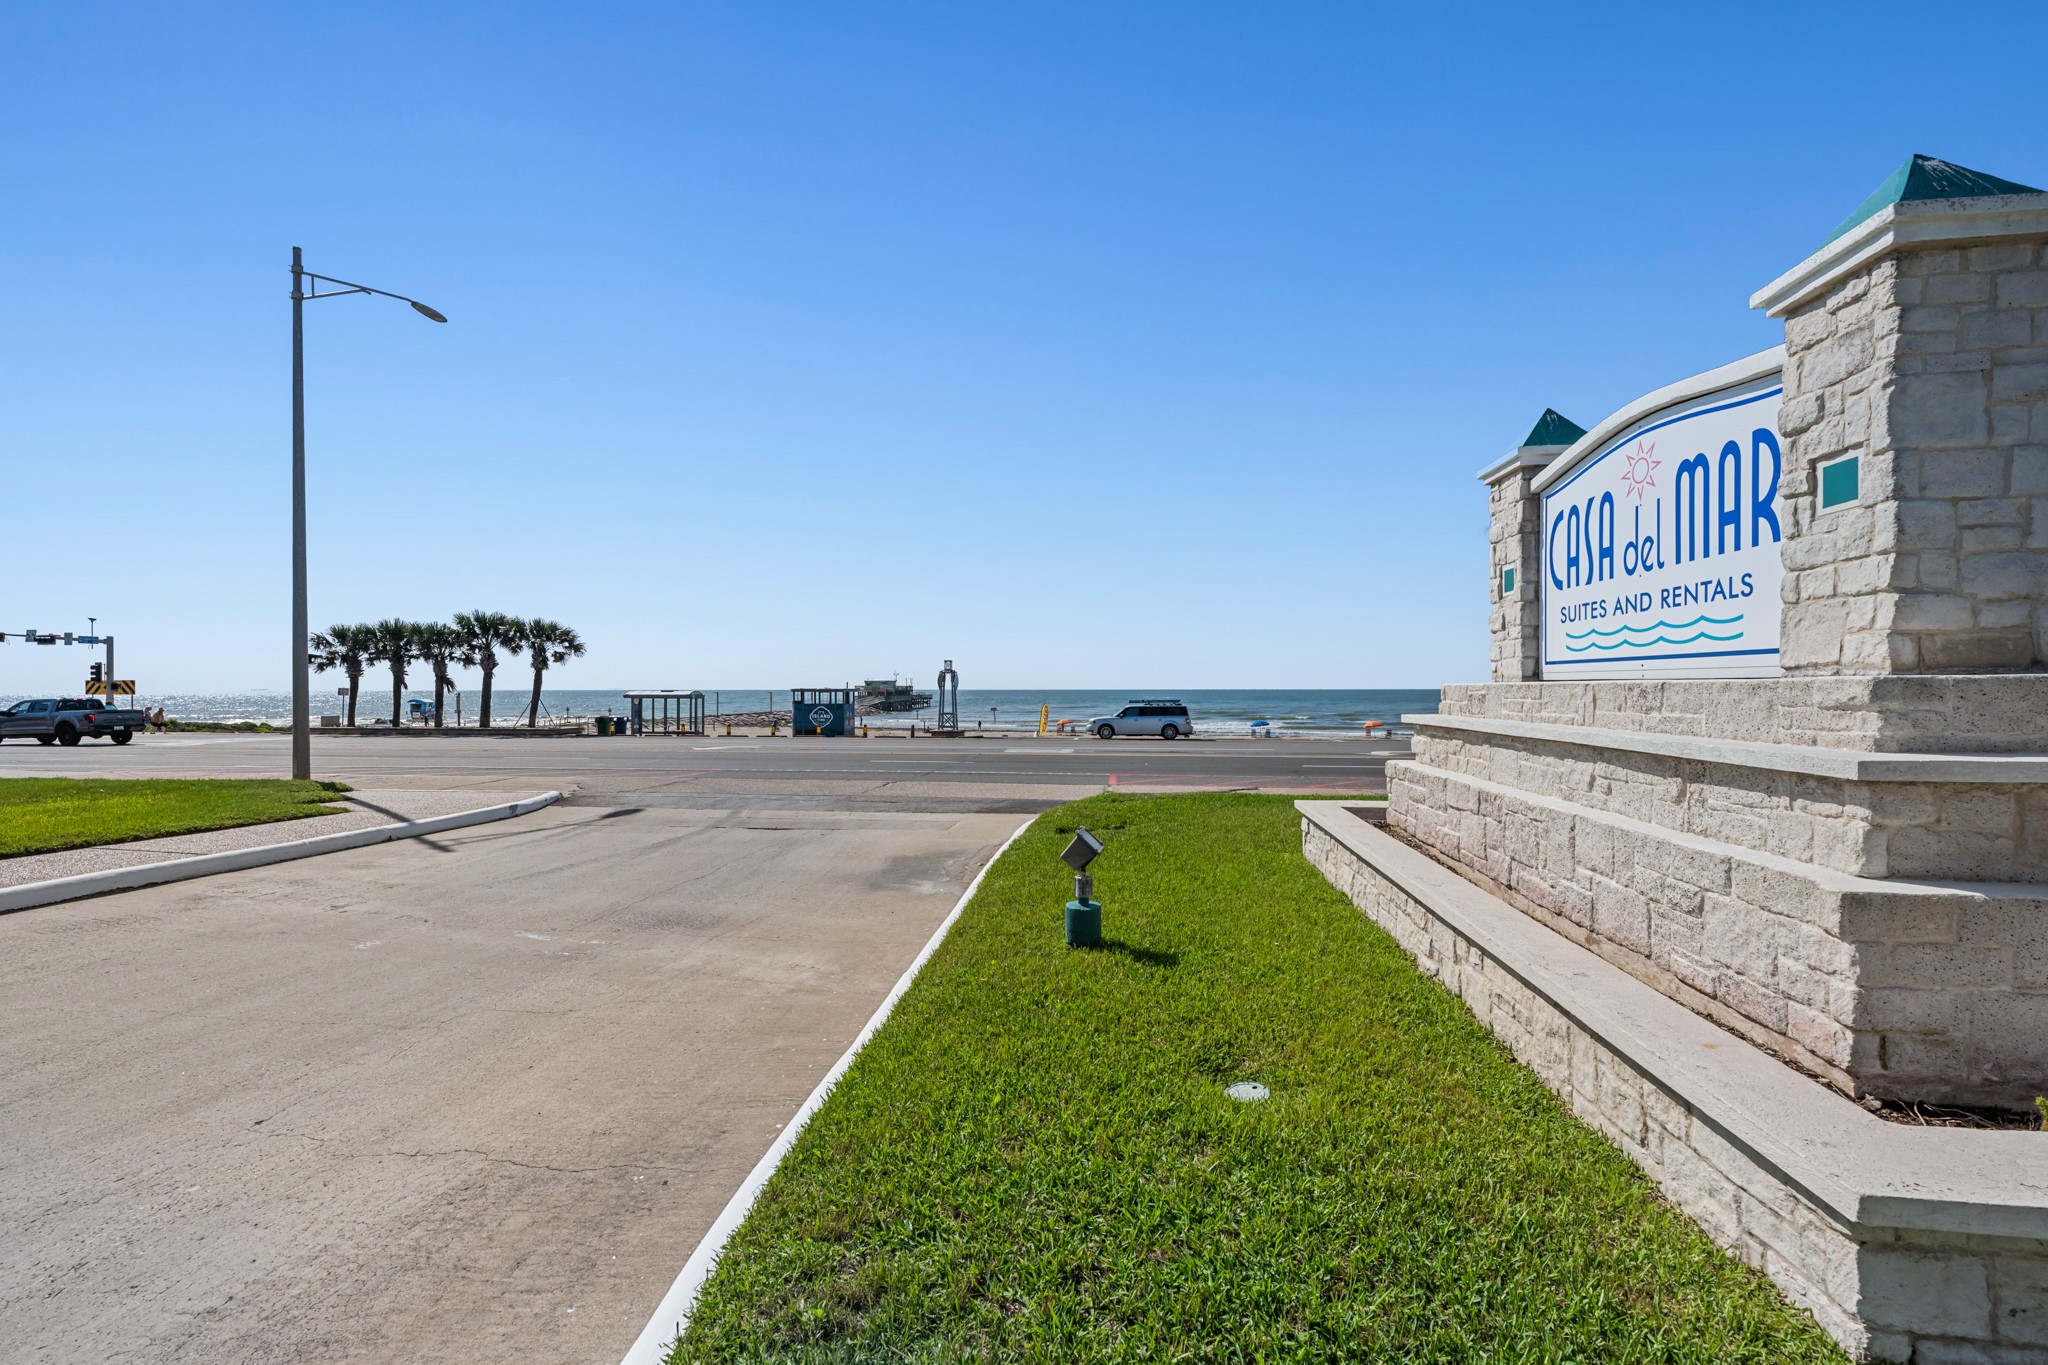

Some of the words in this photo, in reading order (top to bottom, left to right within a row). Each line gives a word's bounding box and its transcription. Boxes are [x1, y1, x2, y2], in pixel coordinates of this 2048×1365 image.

[1549, 491, 1615, 591] CASA
[1623, 498, 1665, 577] del
[1675, 427, 1782, 565] MAR
[1560, 600, 1607, 624] SUITES
[1612, 592, 1652, 616] AND
[1660, 572, 1754, 609] RENTALS
